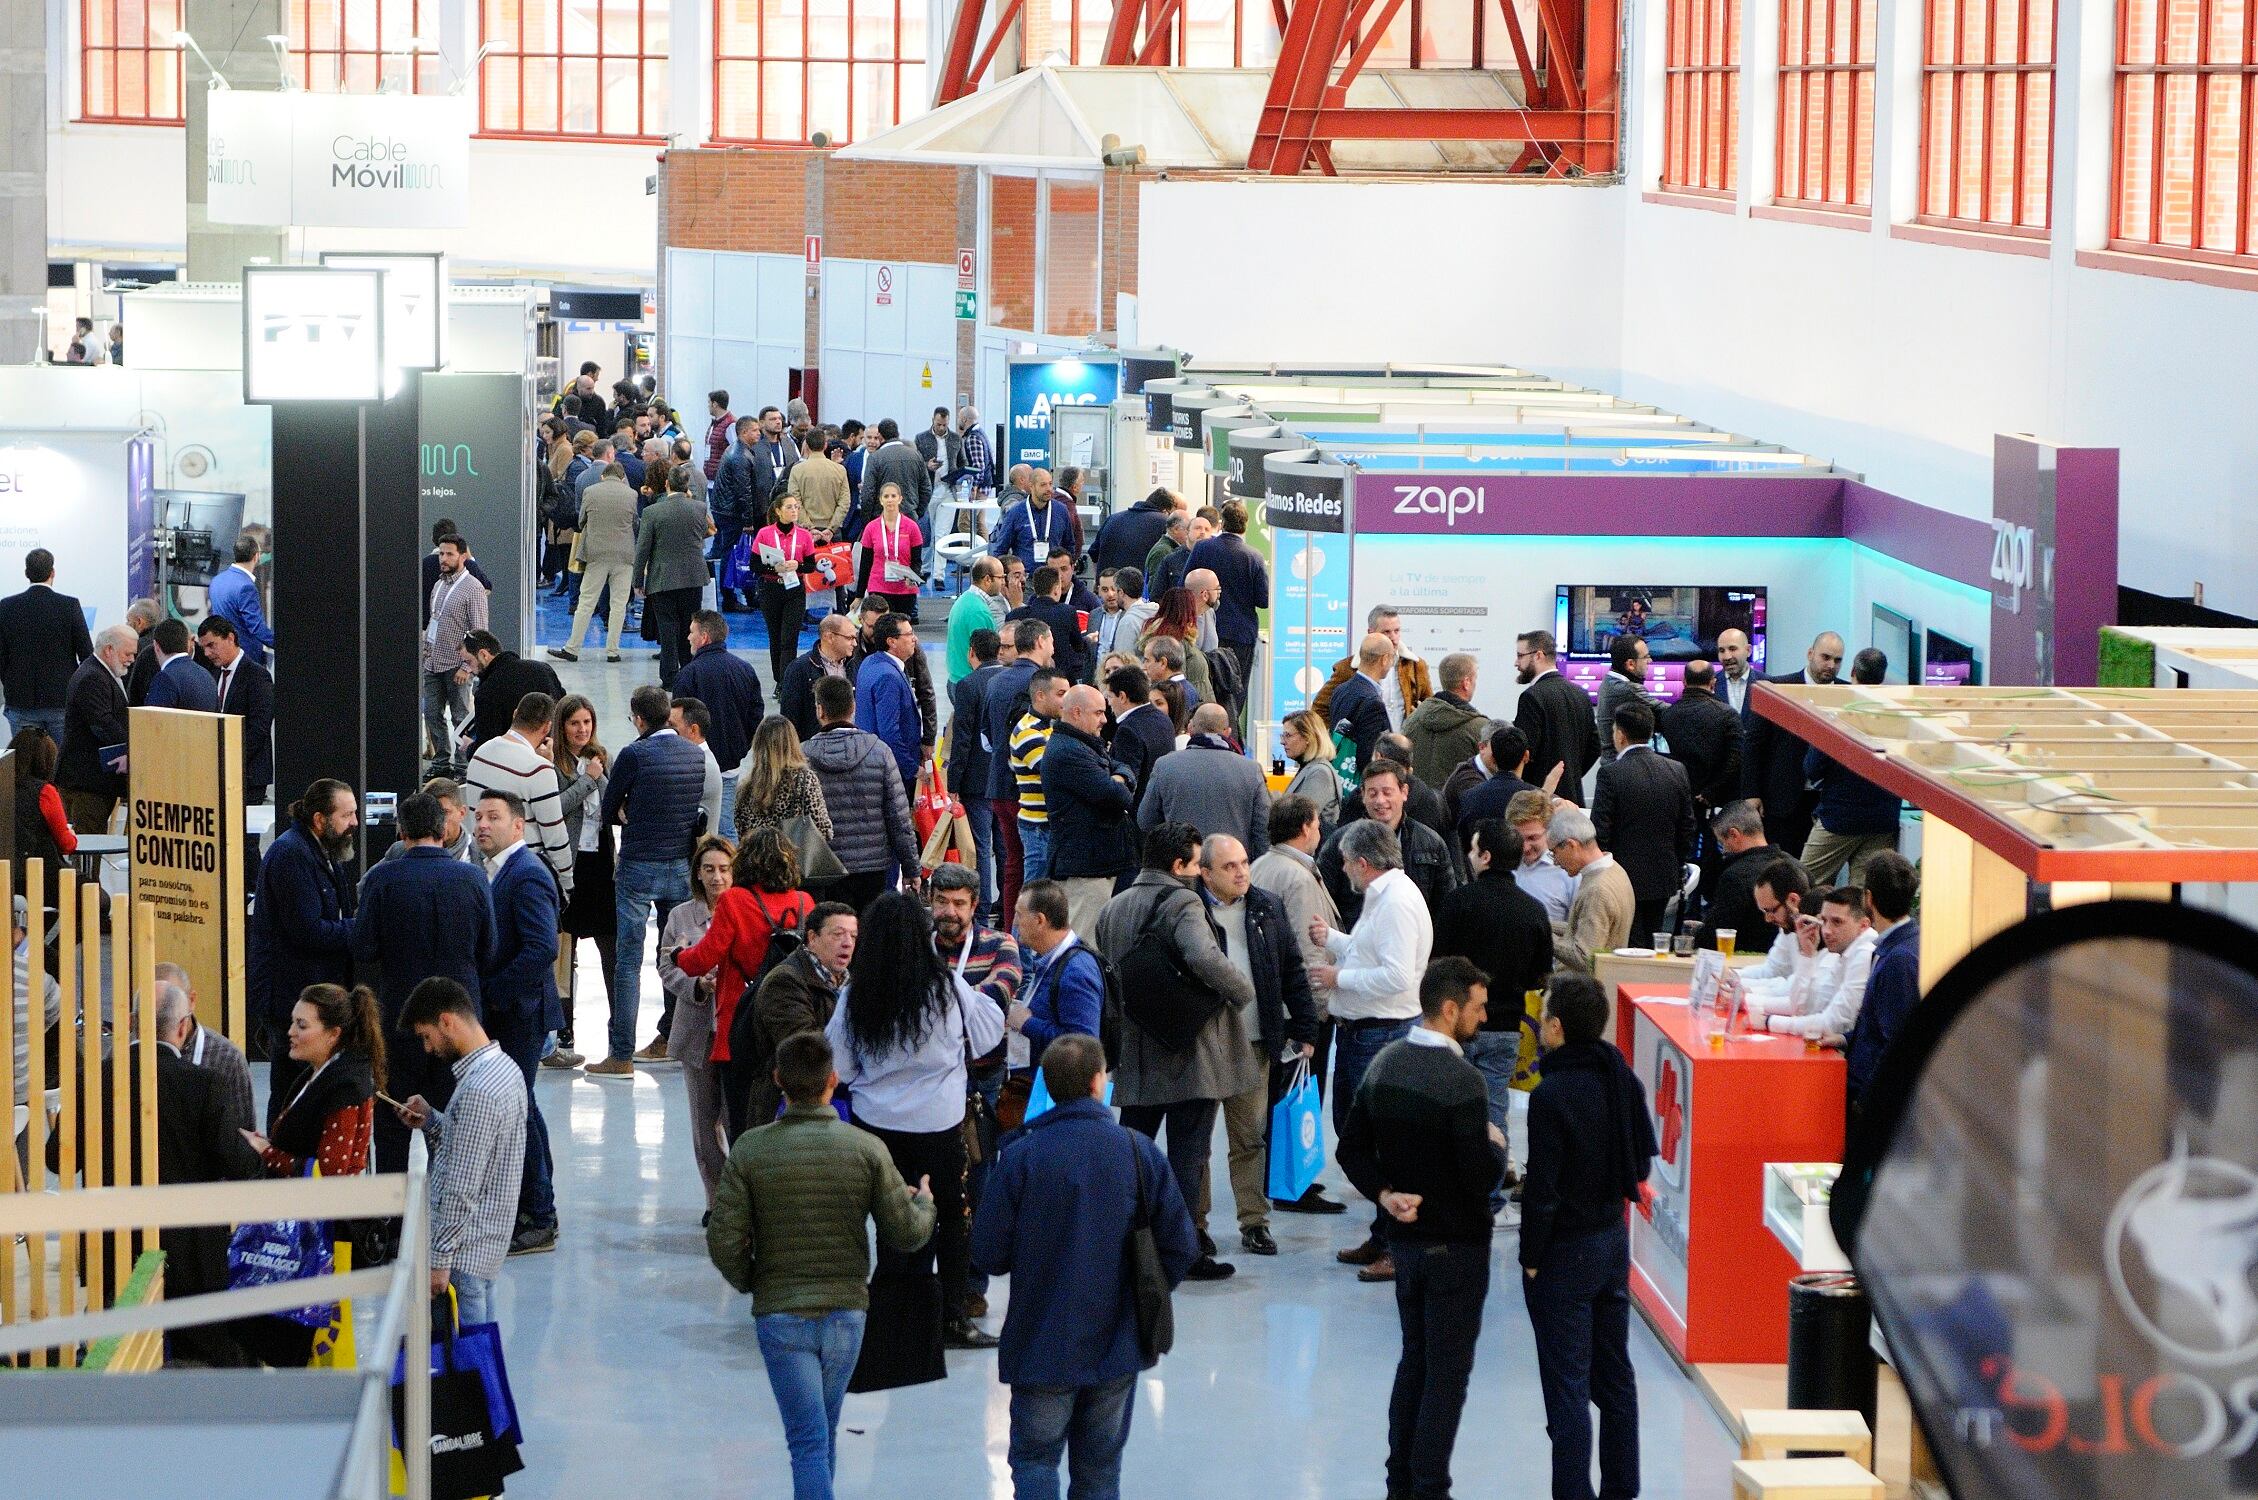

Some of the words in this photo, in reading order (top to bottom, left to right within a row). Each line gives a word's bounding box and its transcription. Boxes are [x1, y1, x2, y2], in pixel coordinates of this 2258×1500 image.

[332, 135, 407, 161] Cable
[332, 163, 404, 189] Móvil
[1015, 415, 1050, 429] NET
[433, 487, 457, 498] lejos.
[1296, 491, 1342, 516] Redes
[1393, 485, 1485, 527] zapi
[19, 539, 41, 548] local
[1407, 573, 1422, 582] TV
[1990, 517, 2035, 614] zapi
[135, 799, 215, 838] SIEMPRE
[136, 833, 216, 873] CONTIGO
[139, 876, 157, 888] para
[159, 879, 195, 893] nosotros,
[139, 892, 187, 907] compromiso
[188, 898, 199, 907] no
[200, 900, 209, 910] es
[157, 910, 172, 920] una
[173, 910, 206, 925] palabra.
[432, 1431, 485, 1455] BANDALIBRE
